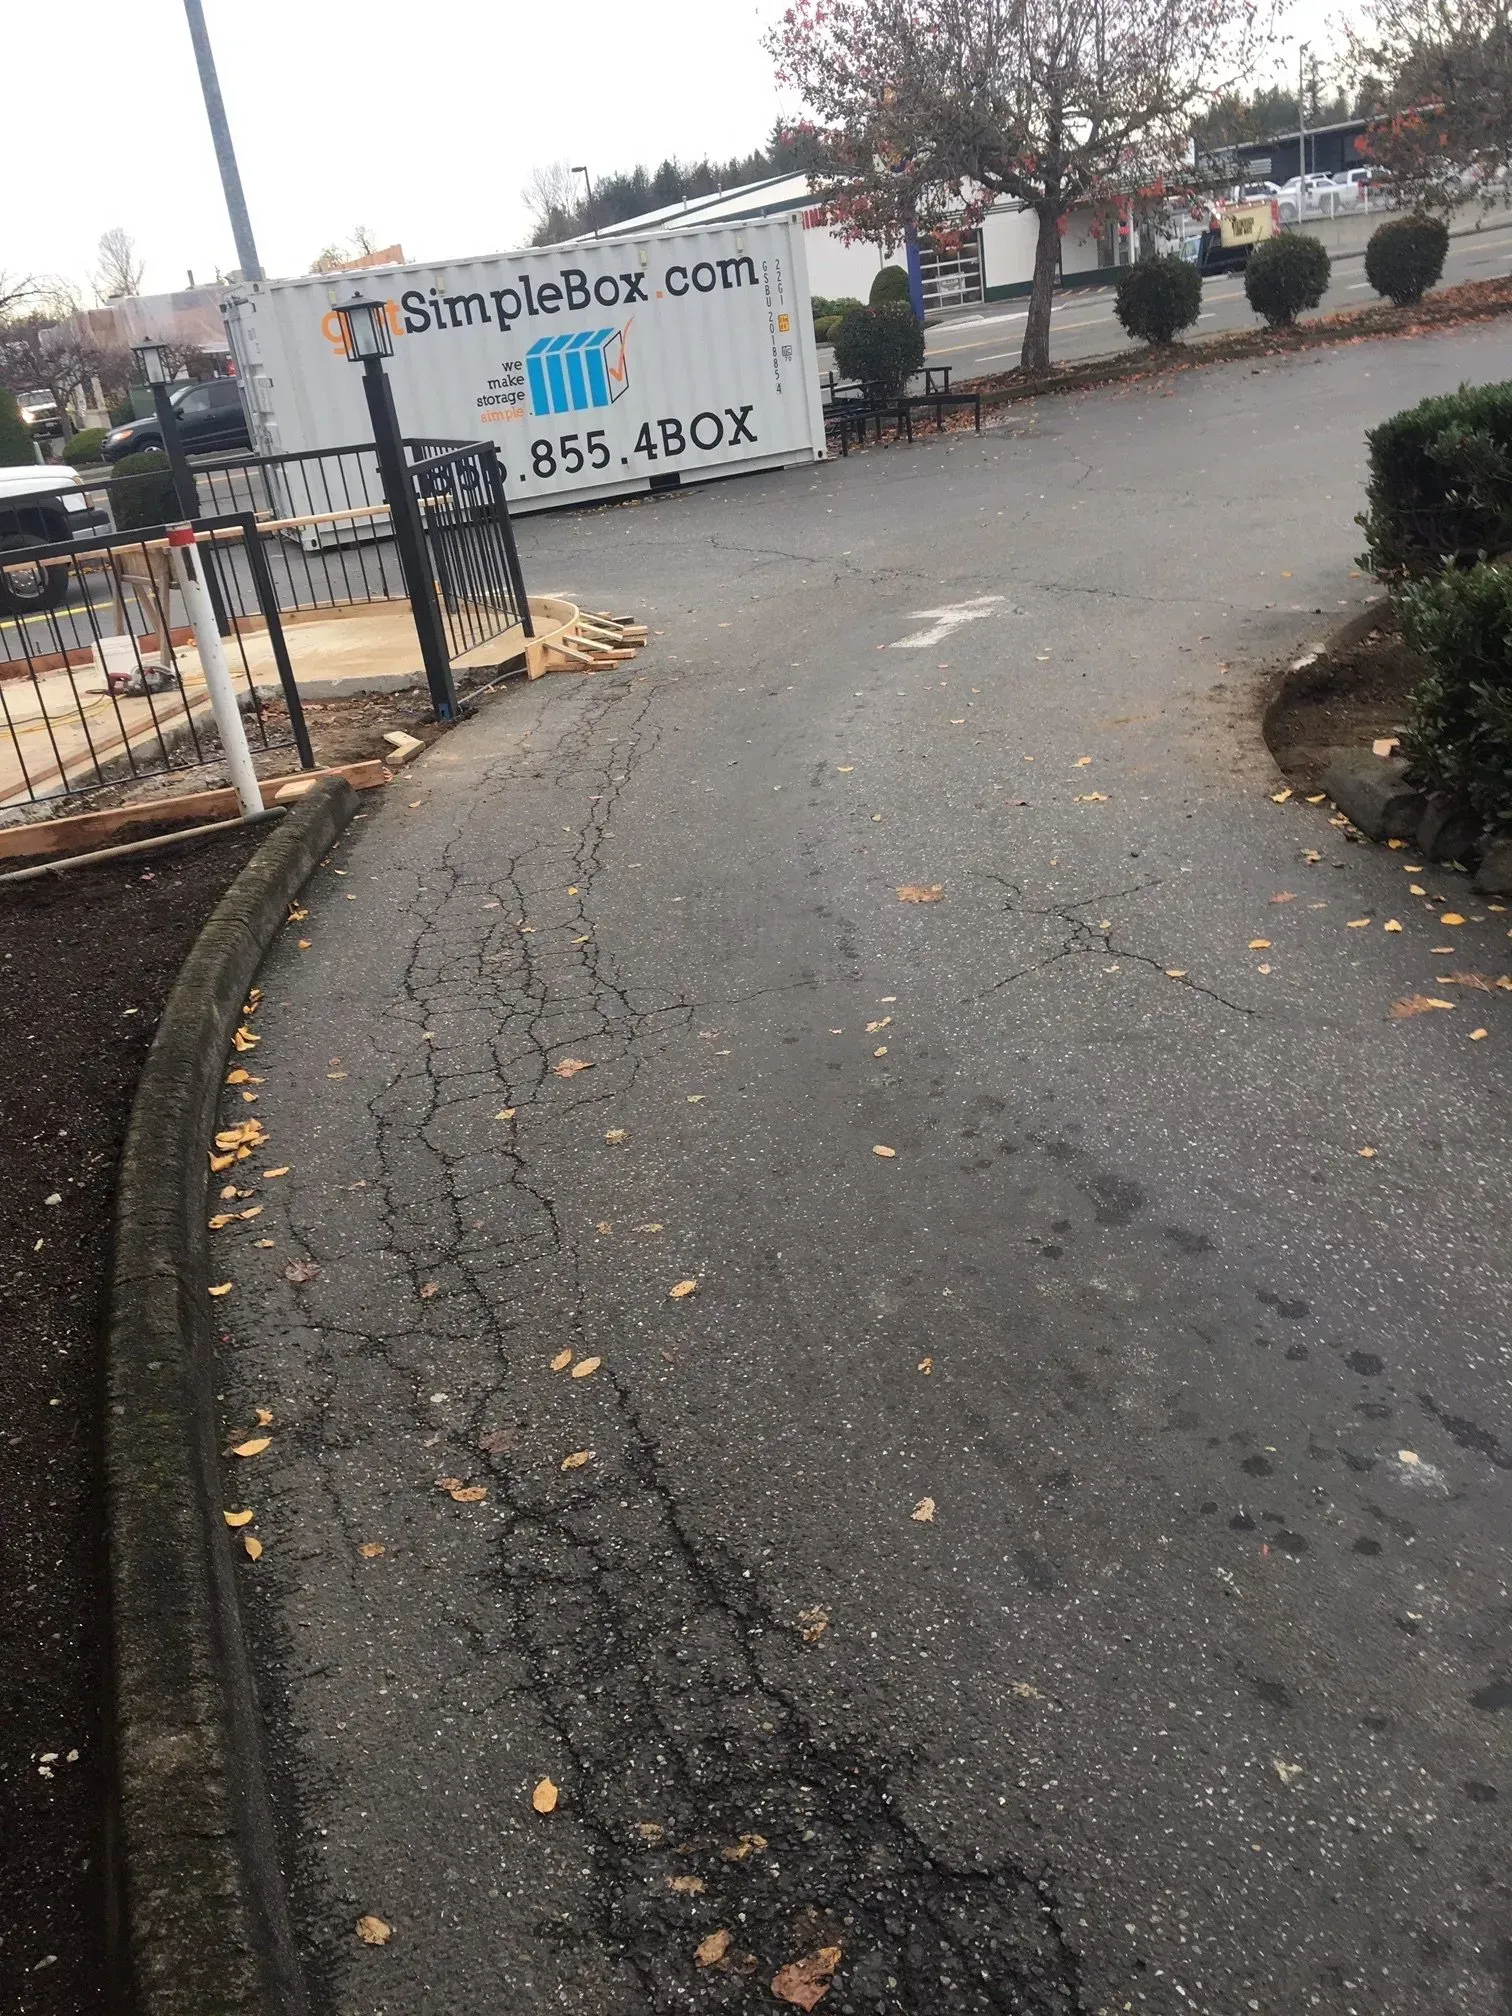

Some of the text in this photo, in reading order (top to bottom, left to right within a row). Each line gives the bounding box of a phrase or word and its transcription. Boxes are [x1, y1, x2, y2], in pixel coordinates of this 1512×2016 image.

[321, 255, 759, 355] gtSimpleBox.com
[502, 360, 523, 372] we
[487, 374, 525, 389] make
[477, 391, 525, 407] storage
